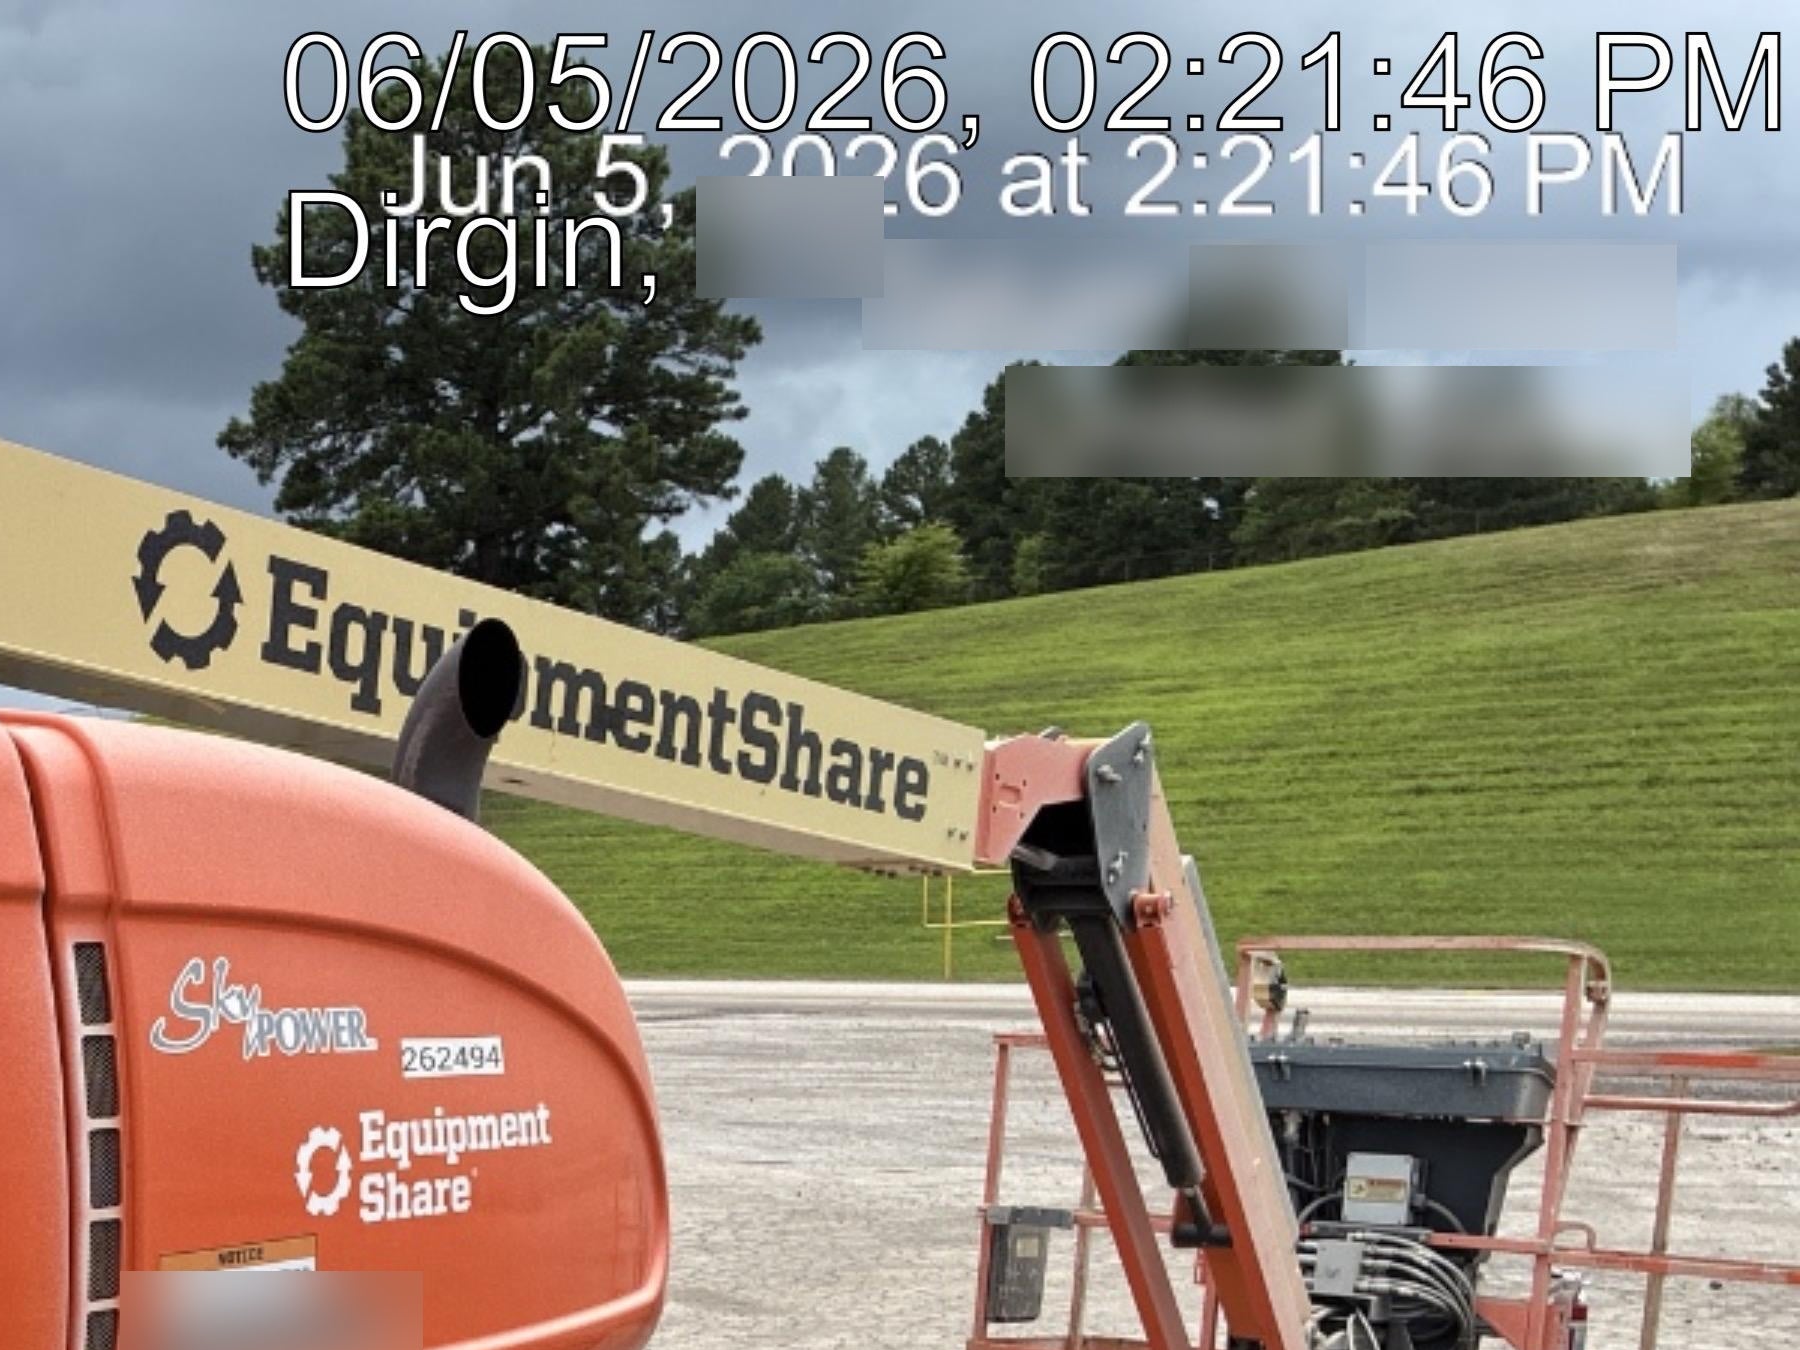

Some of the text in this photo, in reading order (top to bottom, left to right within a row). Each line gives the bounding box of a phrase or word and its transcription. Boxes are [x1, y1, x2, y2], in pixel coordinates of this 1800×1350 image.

[401, 1044, 501, 1073] 262494
[358, 1102, 553, 1170] Equipment
[358, 1171, 472, 1224] Share
